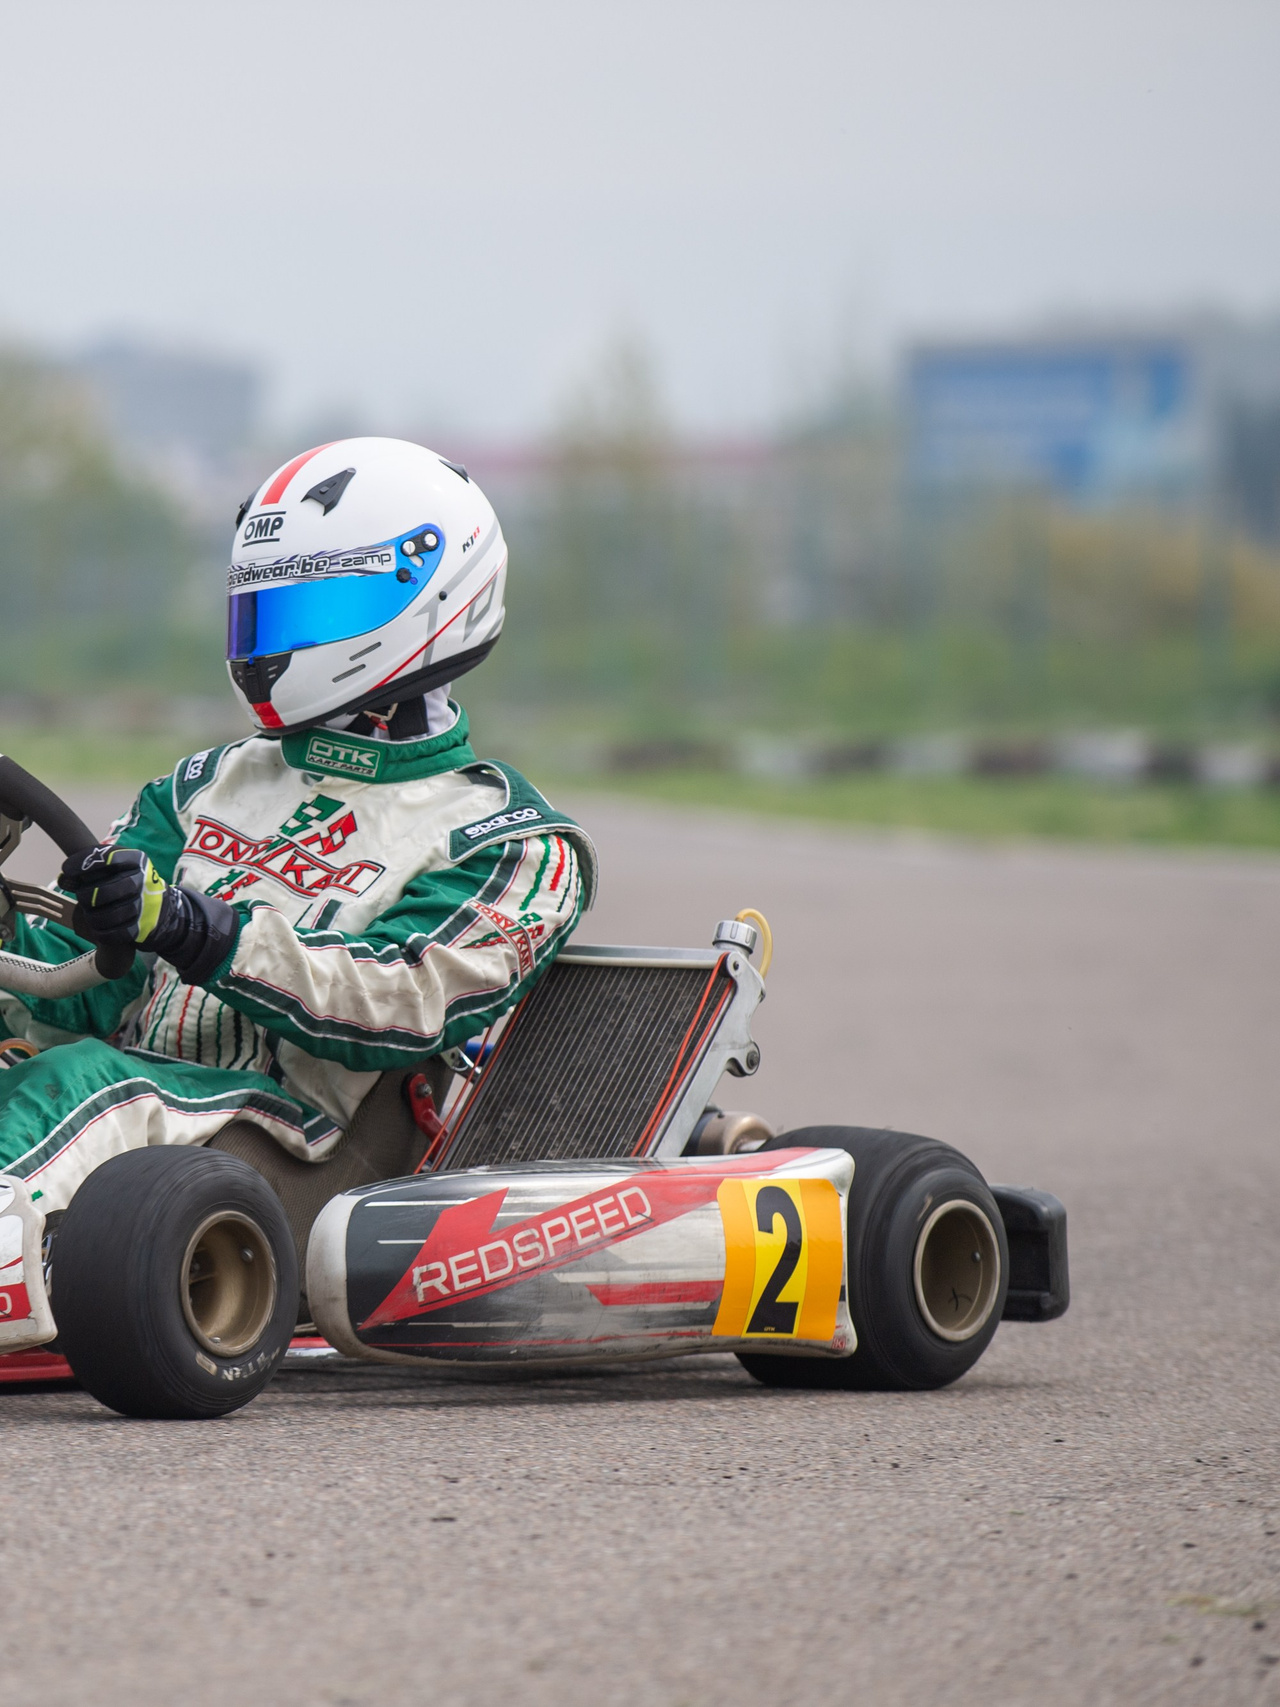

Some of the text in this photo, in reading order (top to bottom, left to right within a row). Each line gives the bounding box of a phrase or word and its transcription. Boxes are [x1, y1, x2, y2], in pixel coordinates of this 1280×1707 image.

[244, 516, 284, 541] OMP
[341, 553, 392, 568] zamp
[309, 754, 375, 776] KART PARTS
[311, 740, 376, 767] OTK
[464, 807, 540, 838] sparco
[185, 819, 381, 894] TONY KART
[413, 1186, 652, 1303] REDSPEED
[746, 1185, 804, 1335] 2
